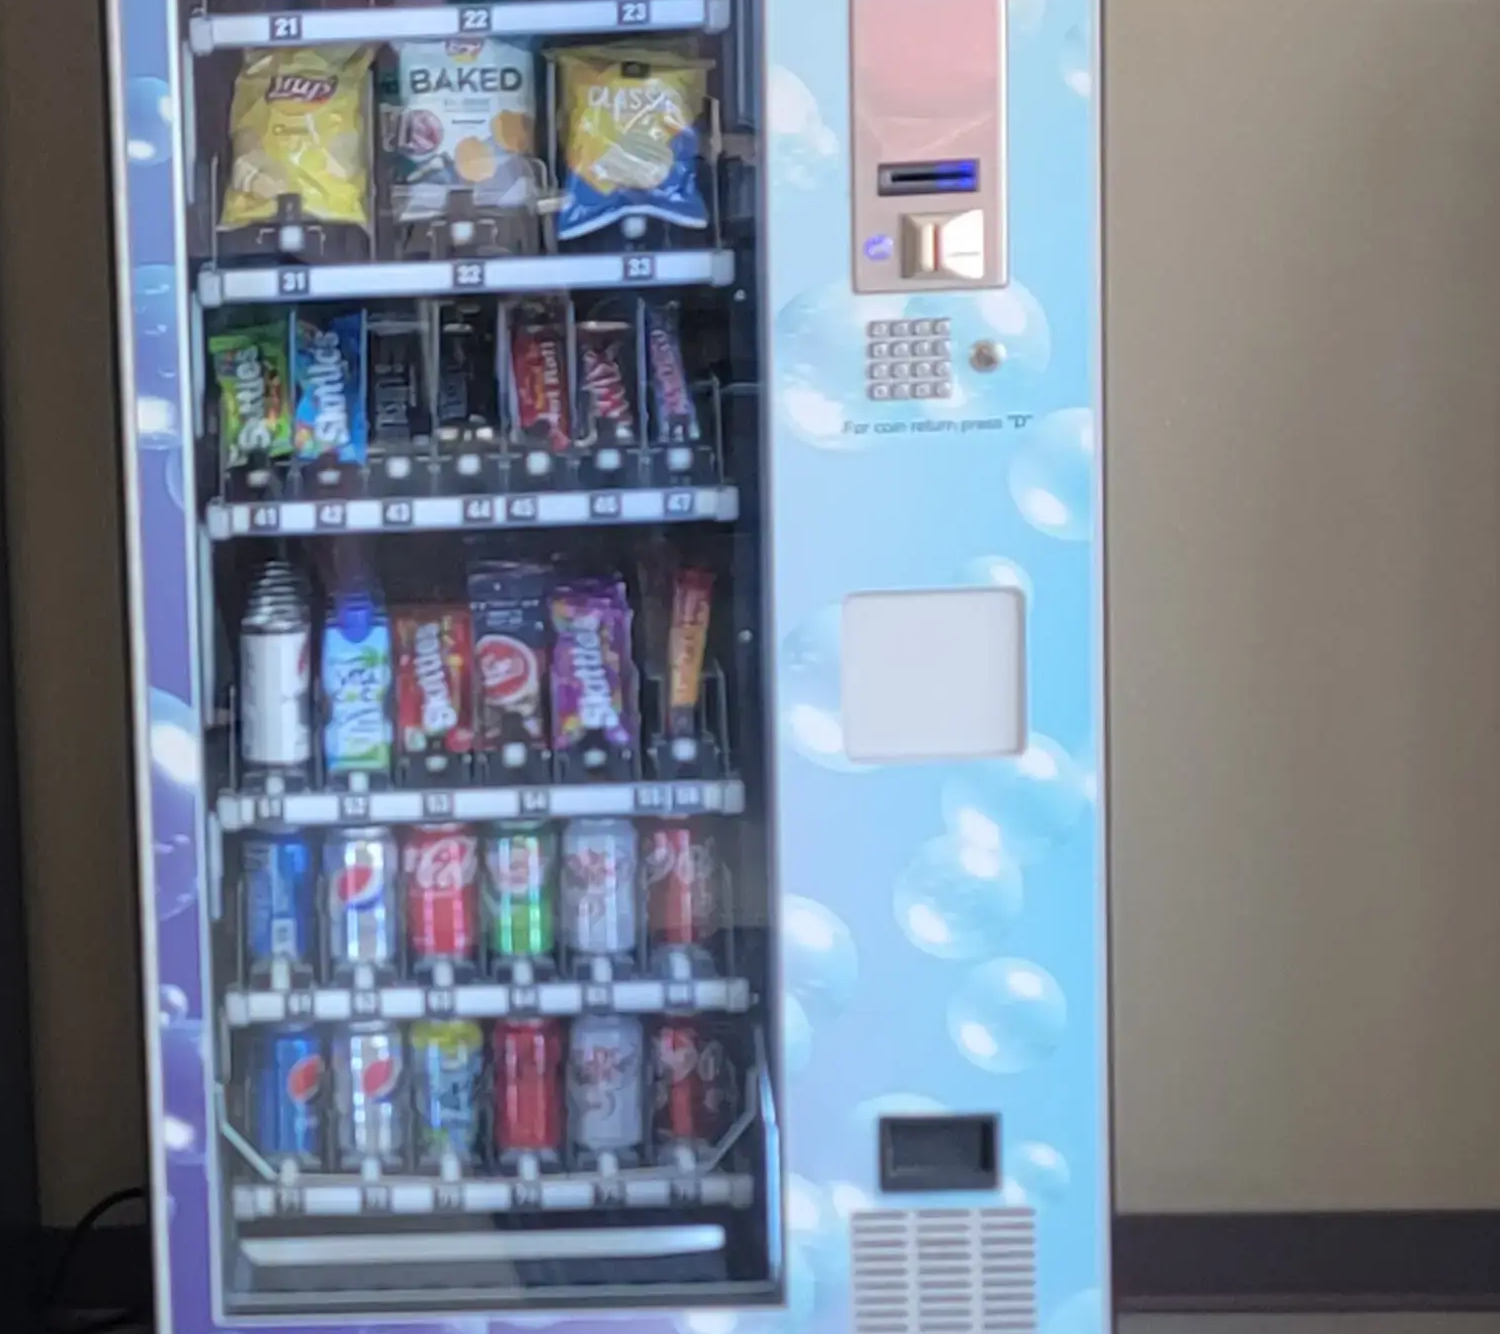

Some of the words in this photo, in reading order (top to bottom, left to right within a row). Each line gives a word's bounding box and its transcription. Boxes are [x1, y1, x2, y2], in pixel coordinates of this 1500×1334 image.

[462, 9, 488, 28] 22
[622, 2, 647, 22] 23
[274, 18, 297, 37] 21
[409, 68, 523, 94] BAKED
[283, 273, 305, 292] 31
